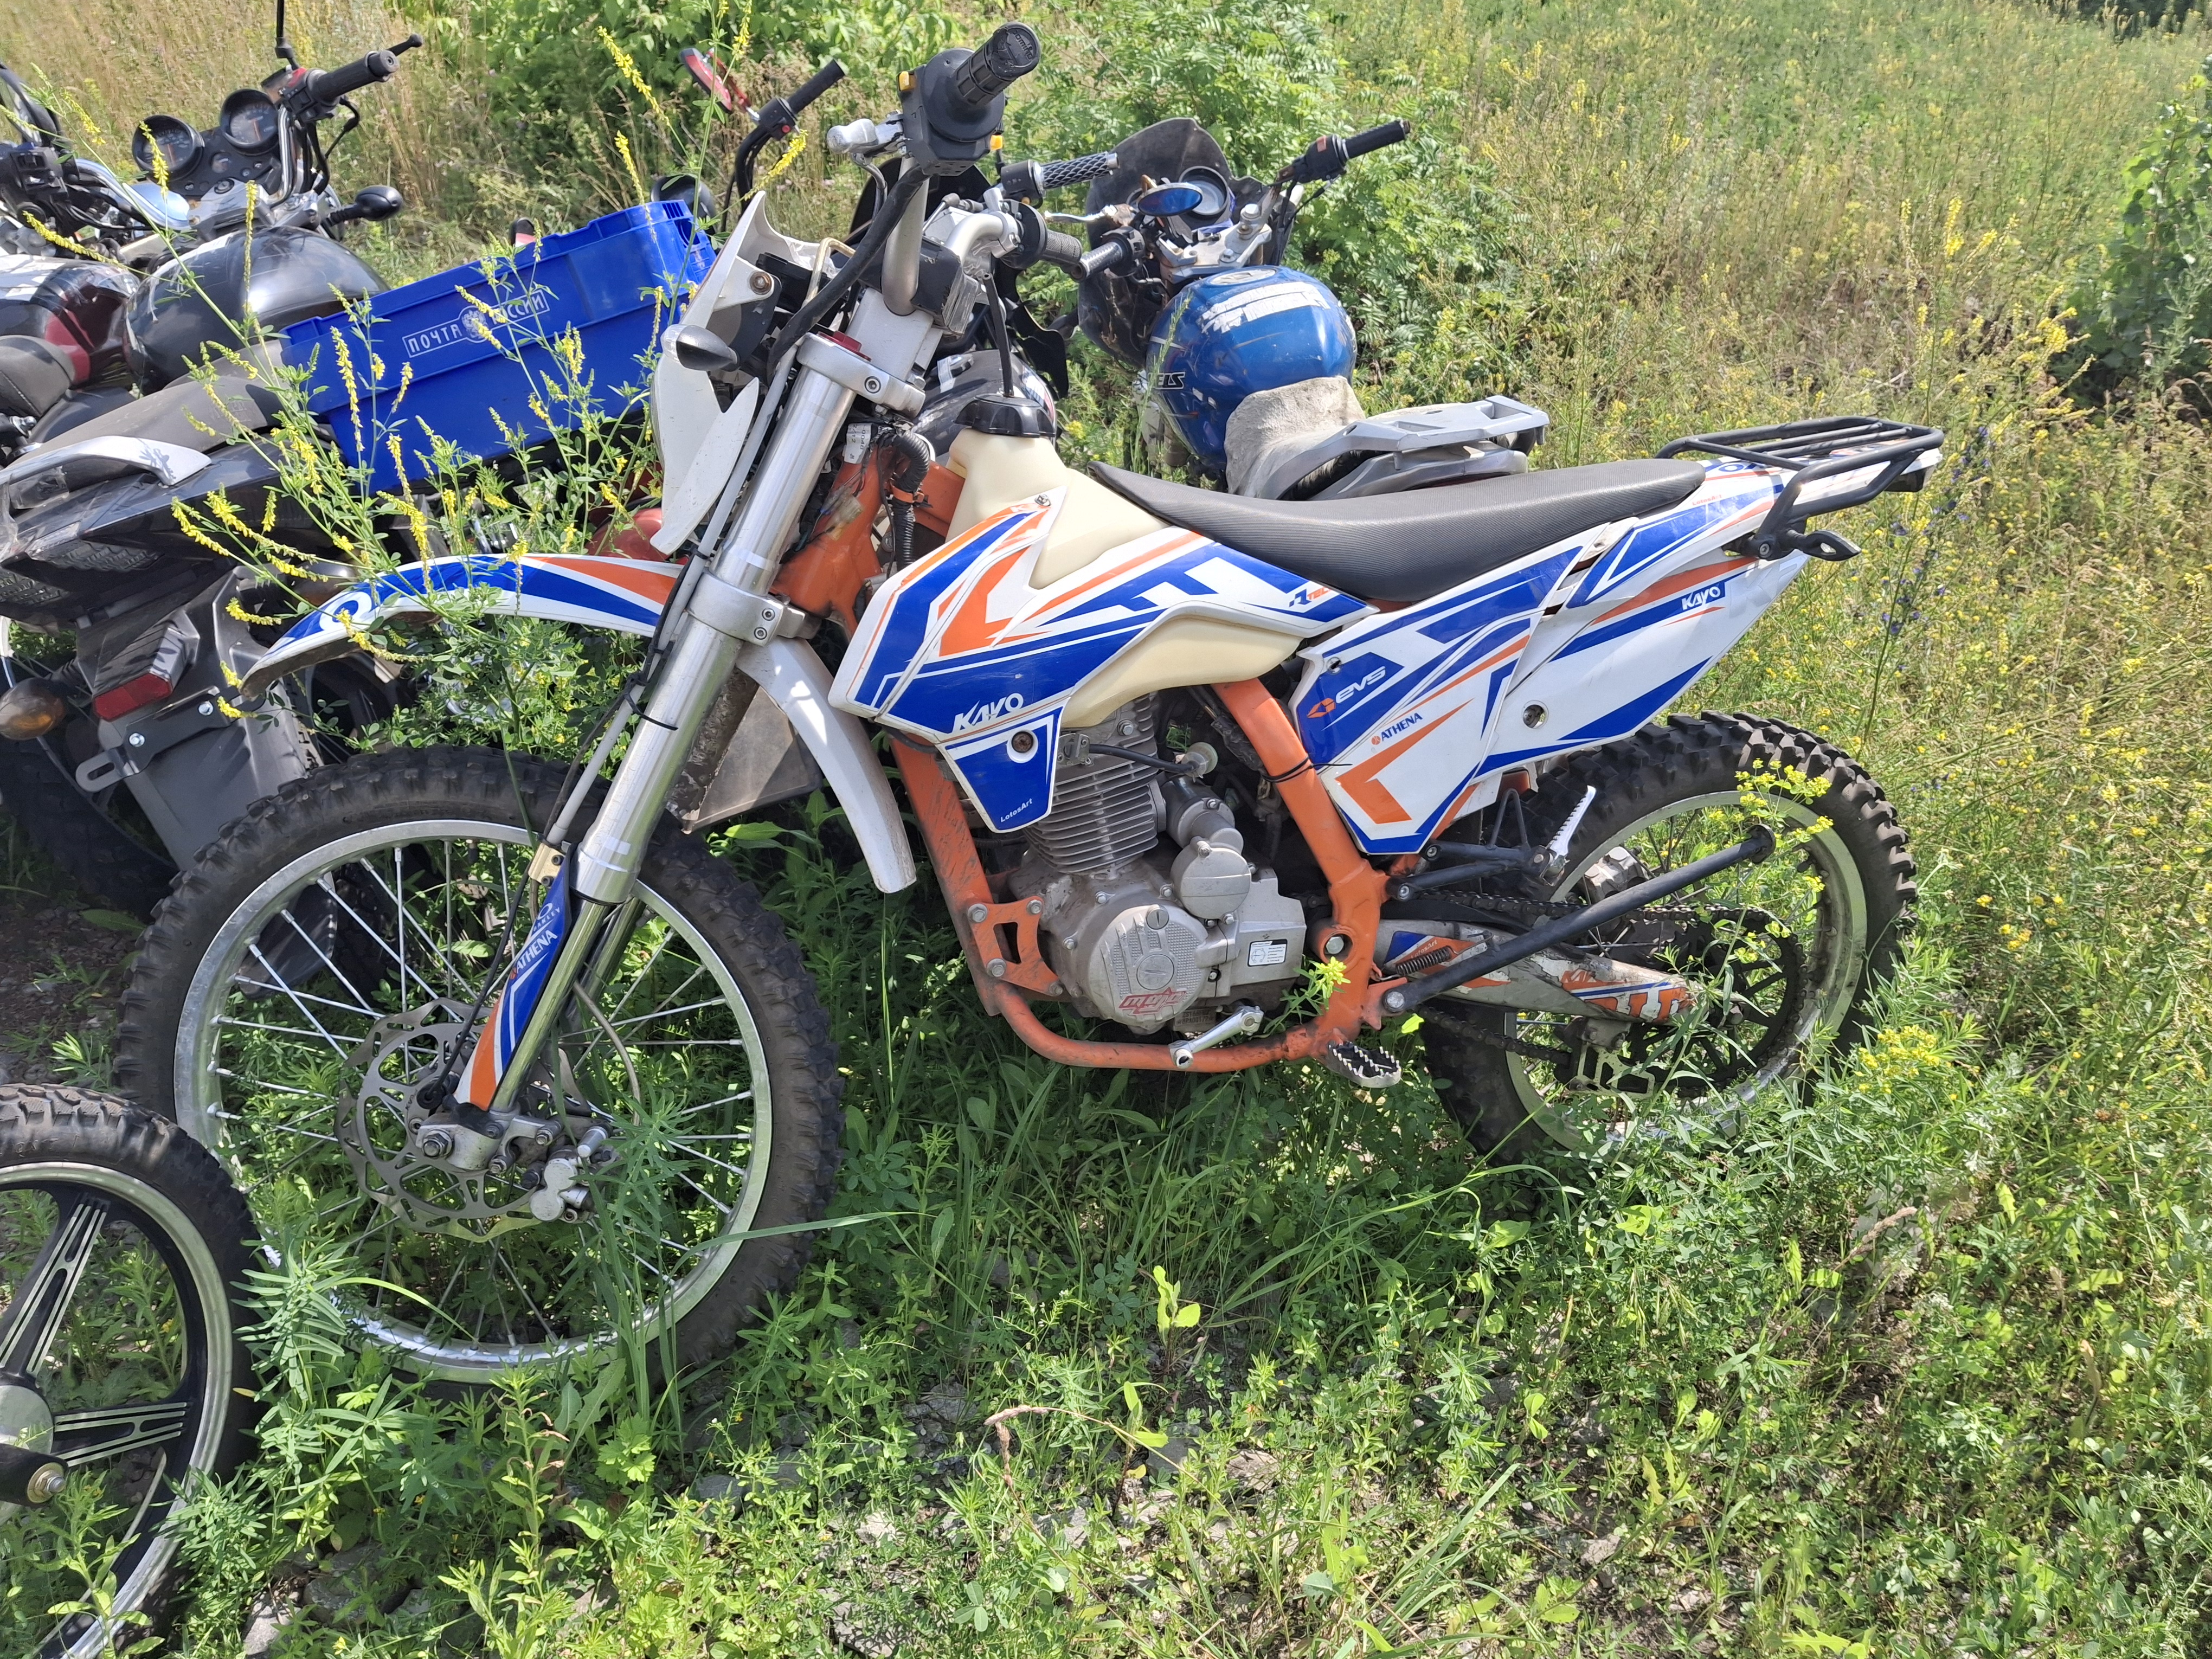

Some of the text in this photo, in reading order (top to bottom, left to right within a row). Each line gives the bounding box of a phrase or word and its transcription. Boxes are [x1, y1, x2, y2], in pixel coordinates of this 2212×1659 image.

[408, 294, 544, 353] ПОЧТА ССИИ
[1681, 586, 1721, 610] KAYO
[952, 693, 1024, 734] KAYO
[1381, 712, 1423, 742] ATHENA
[1000, 798, 1033, 822] LotosArt
[533, 907, 561, 932] OAKLEY
[516, 930, 558, 974] ATHENA
